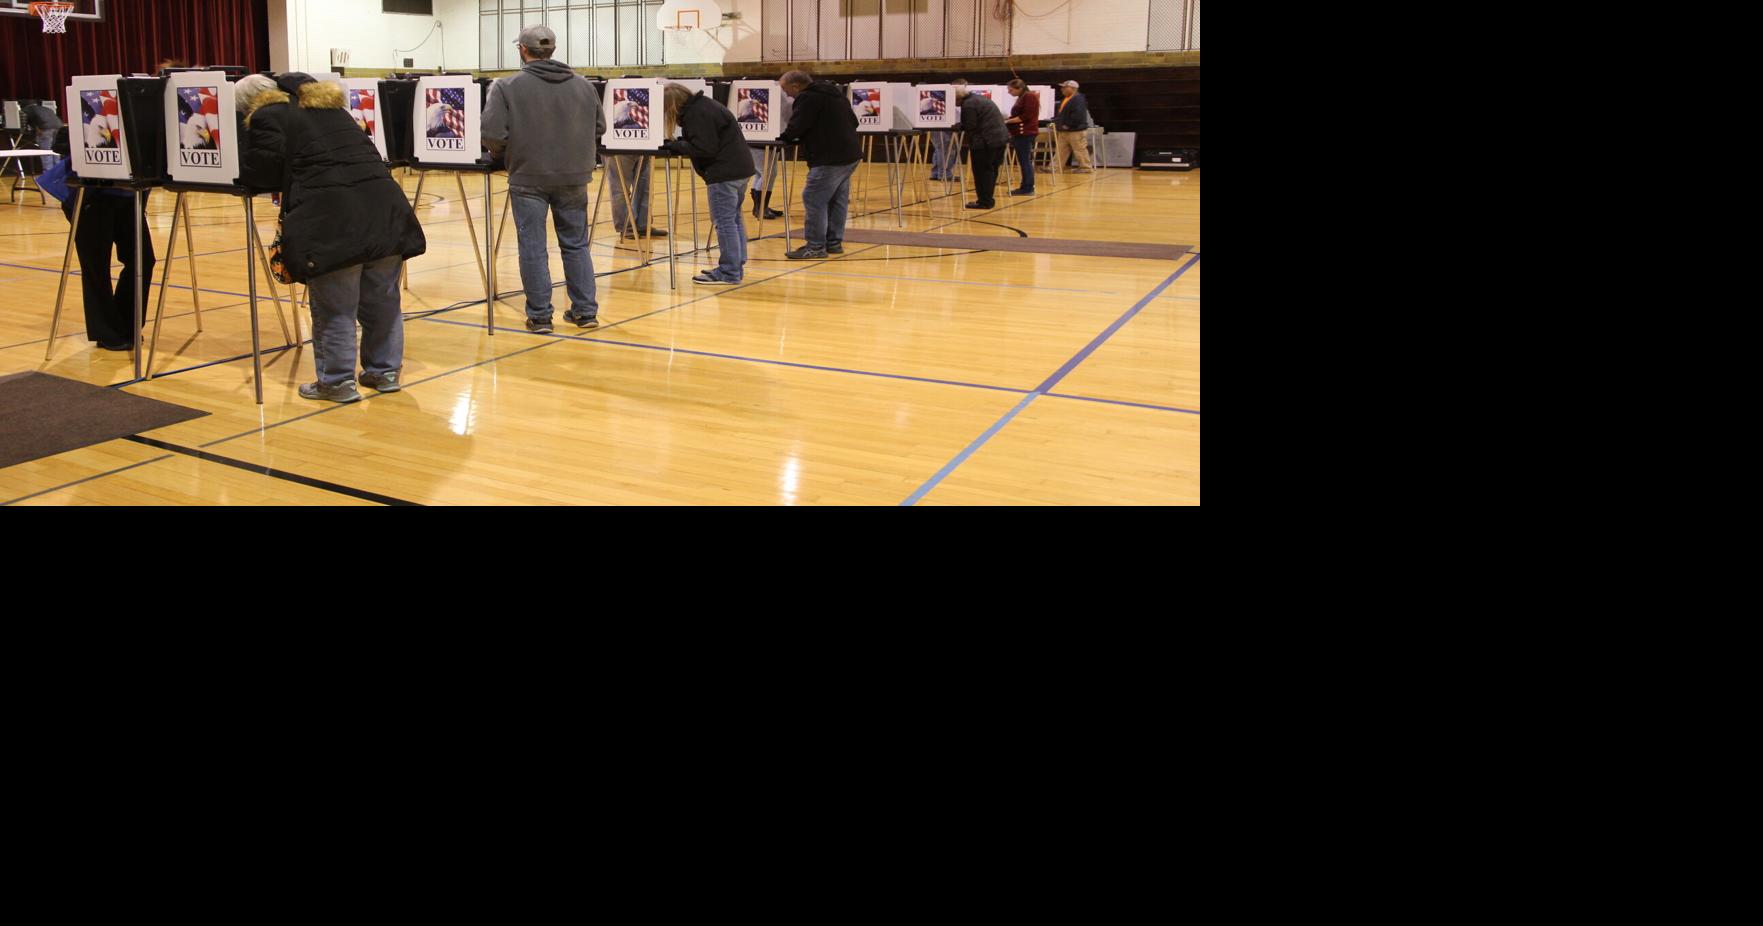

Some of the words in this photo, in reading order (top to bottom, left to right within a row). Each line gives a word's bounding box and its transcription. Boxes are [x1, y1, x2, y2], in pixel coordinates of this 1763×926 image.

[615, 129, 648, 138] VOTE
[428, 138, 463, 149] VOTE
[85, 150, 120, 163] VOTE
[181, 151, 220, 165] VOTE
